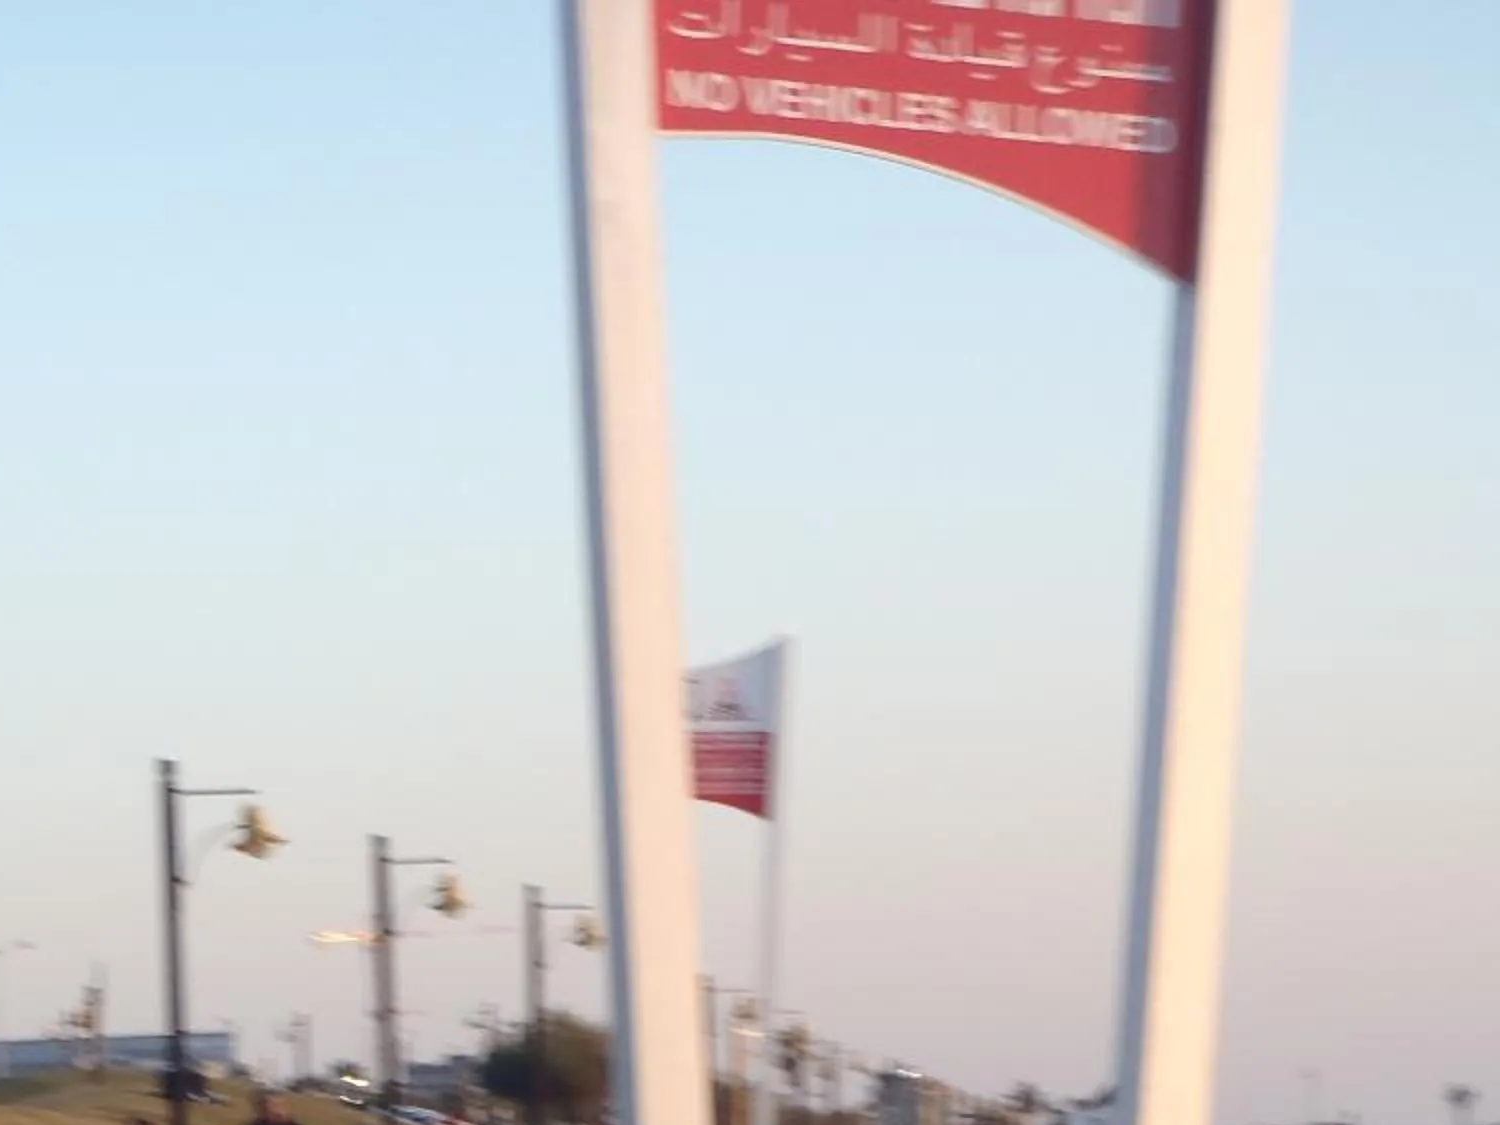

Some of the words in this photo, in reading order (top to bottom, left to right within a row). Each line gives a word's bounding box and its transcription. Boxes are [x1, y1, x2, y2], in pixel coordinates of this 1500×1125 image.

[665, 69, 739, 113] NO
[742, 75, 958, 134] VEHICLES
[963, 100, 1178, 153] ALLOWED
